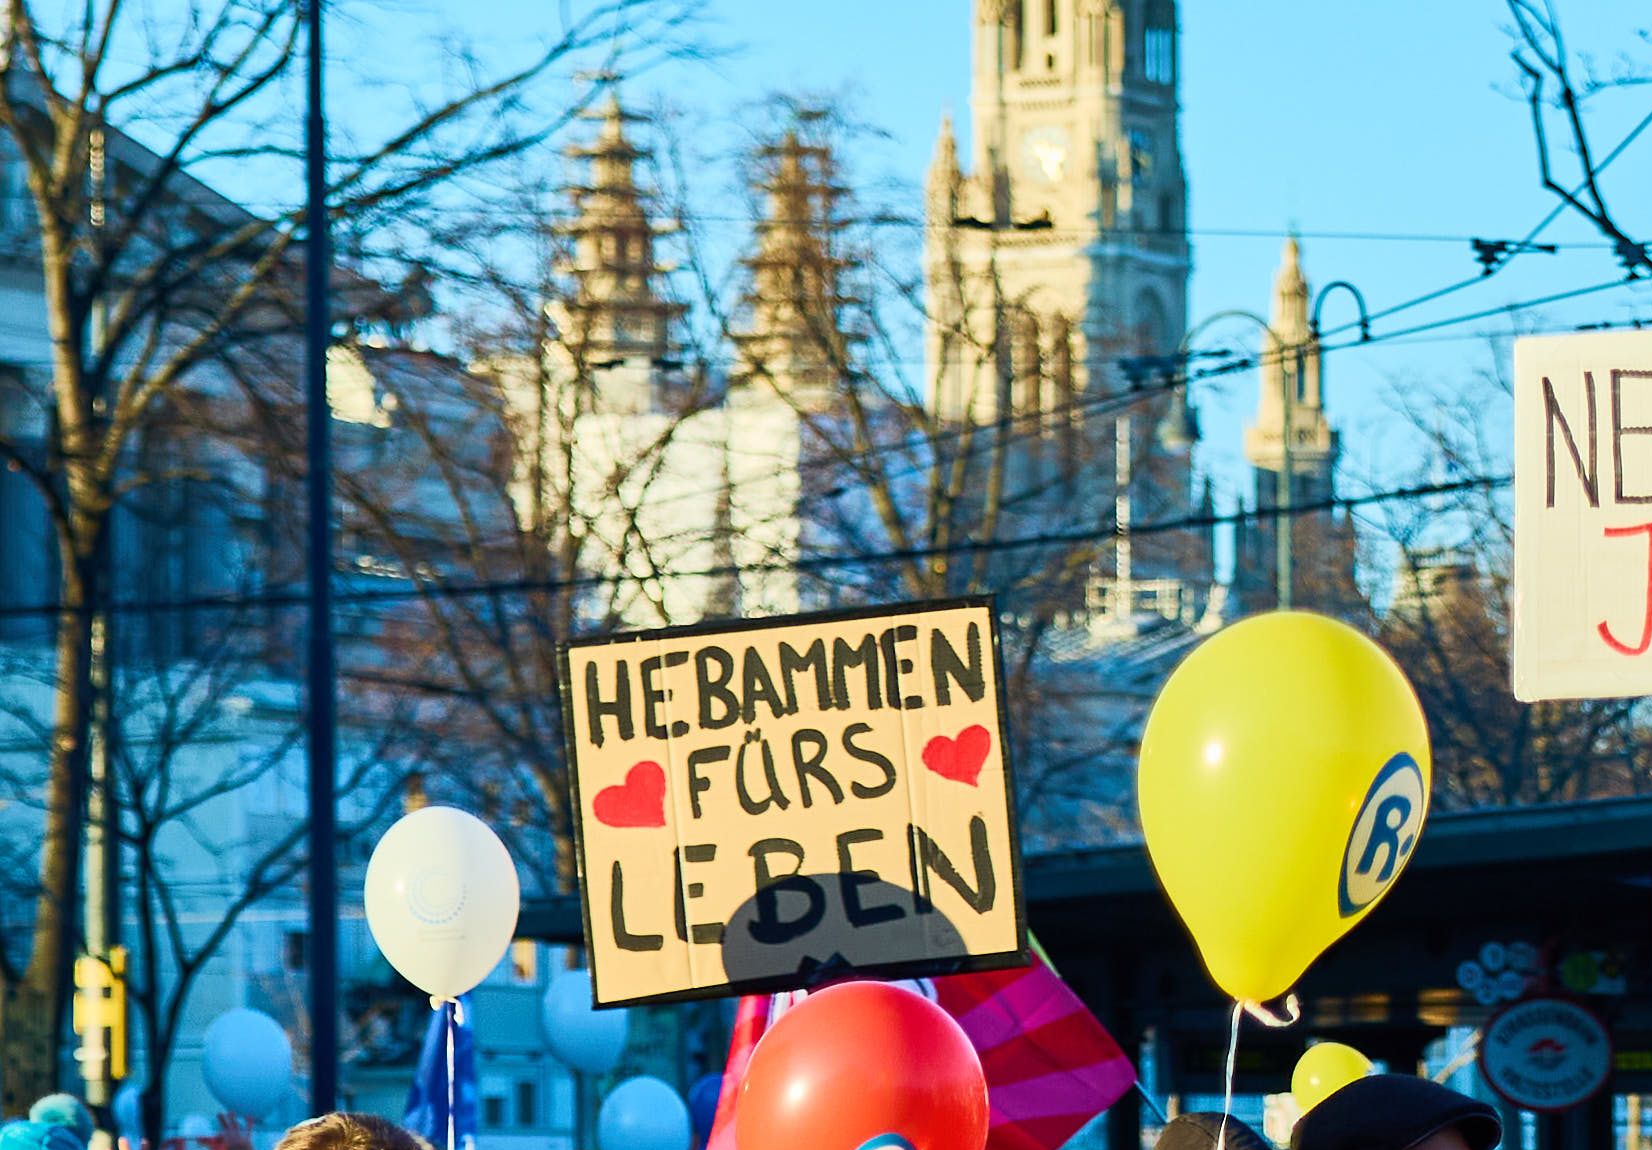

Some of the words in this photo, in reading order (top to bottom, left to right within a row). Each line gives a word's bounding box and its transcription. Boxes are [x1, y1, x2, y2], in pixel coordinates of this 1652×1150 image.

[585, 621, 987, 748] HEBAMMEN
[687, 722, 897, 819] FÜRS
[611, 815, 996, 952] LEBEN
